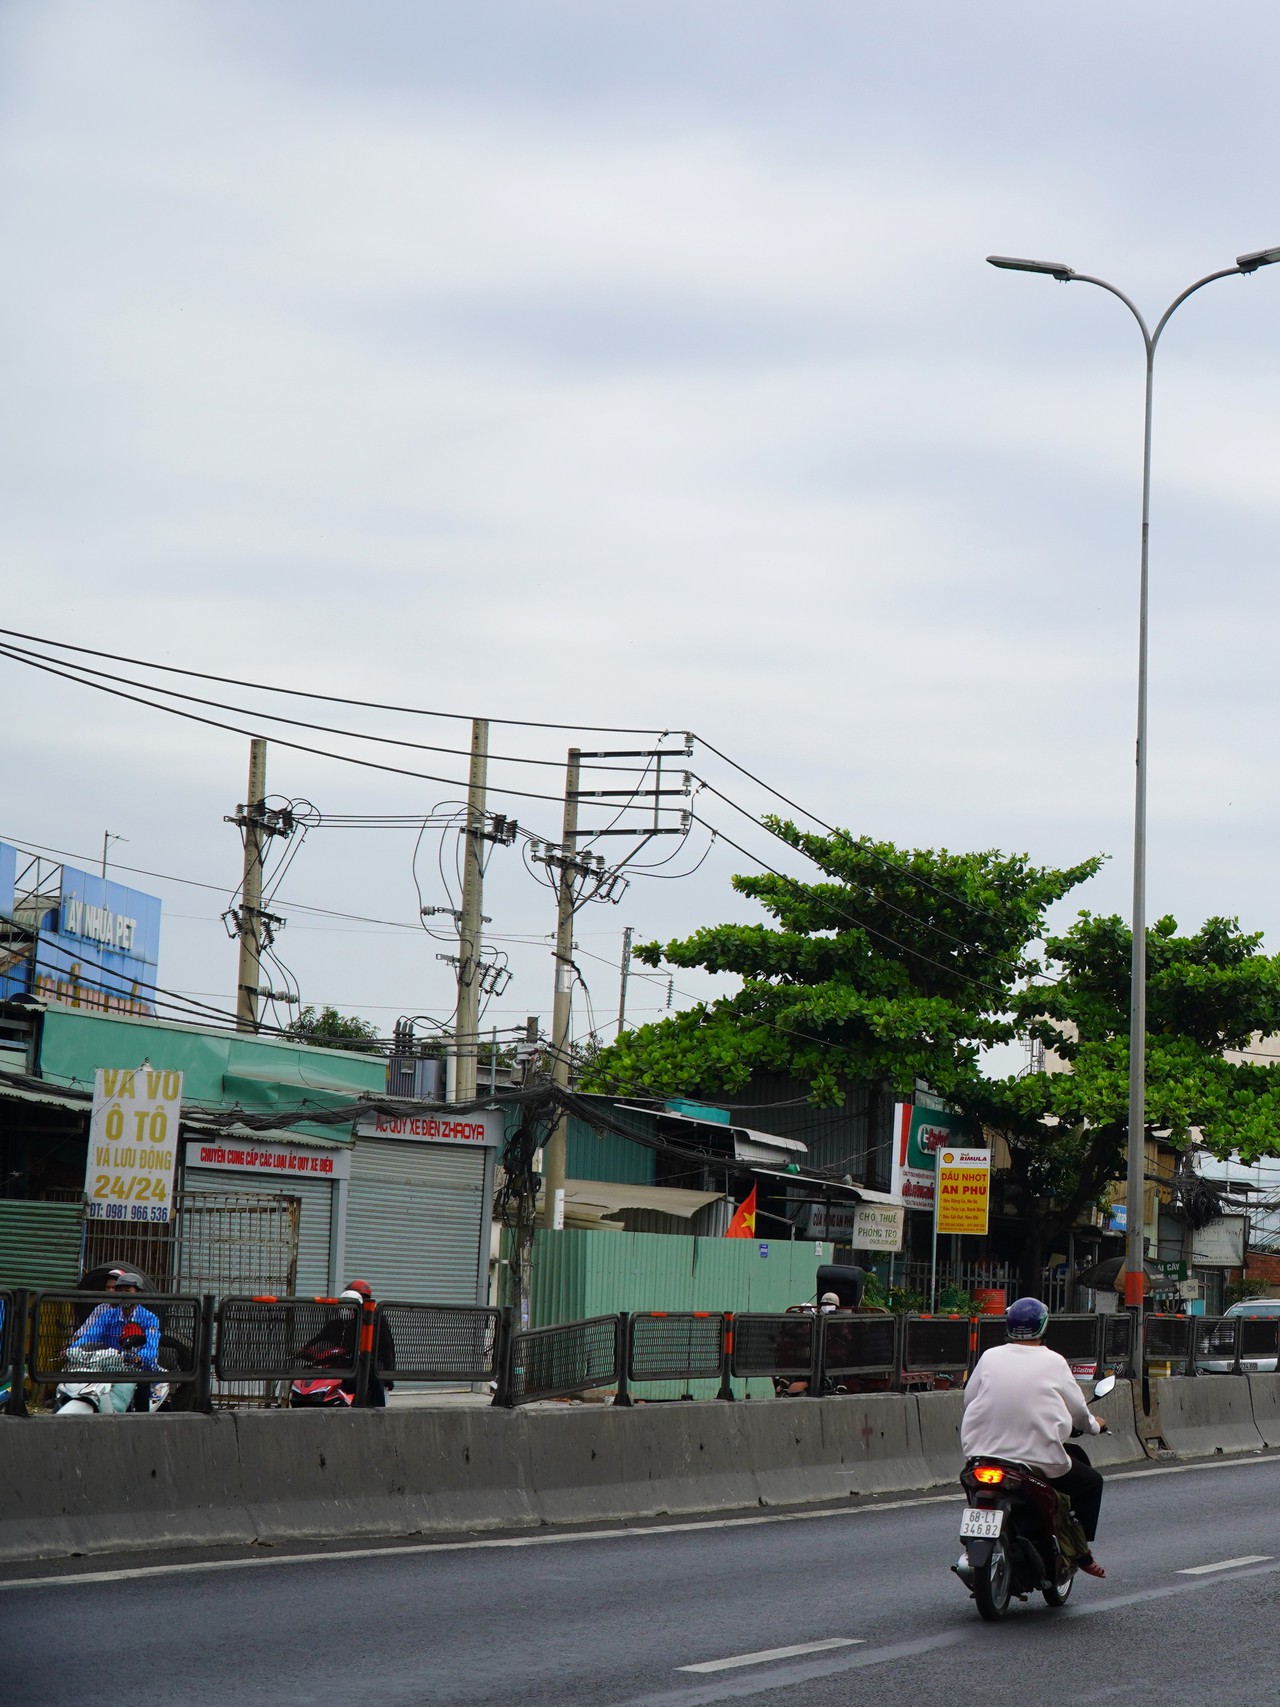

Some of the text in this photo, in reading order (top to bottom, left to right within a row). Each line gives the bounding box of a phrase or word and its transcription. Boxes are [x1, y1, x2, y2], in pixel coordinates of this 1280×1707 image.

[116, 914, 137, 950] PET
[105, 1102, 168, 1143] Ô TÔ
[390, 1117, 408, 1135] QUY
[409, 1119, 421, 1136] XE
[420, 1116, 441, 1140] ĐIỆN
[441, 1120, 485, 1141] ZHAOYA
[96, 1143, 110, 1168] VÁ
[139, 1146, 173, 1175] ĐỘNG
[200, 1146, 226, 1163] CHUYÊN
[227, 1150, 245, 1165] CUNG
[245, 1148, 259, 1167] CẤP
[259, 1152, 273, 1168] CÁC
[272, 1156, 287, 1172] LOẠI
[298, 1157, 310, 1172] QUY
[310, 1157, 319, 1171] XE
[318, 1155, 333, 1174] ĐIỆN
[93, 1174, 167, 1202] 24/24
[941, 1185, 959, 1195] AN
[962, 1183, 987, 1195] PHÚ
[89, 1202, 104, 1219] ĐT:
[105, 1204, 128, 1220] 0981
[150, 1206, 168, 1222] 536
[859, 1211, 876, 1222] CHO
[963, 1523, 998, 1536] 346.82
[969, 1511, 996, 1523] 68-L1
